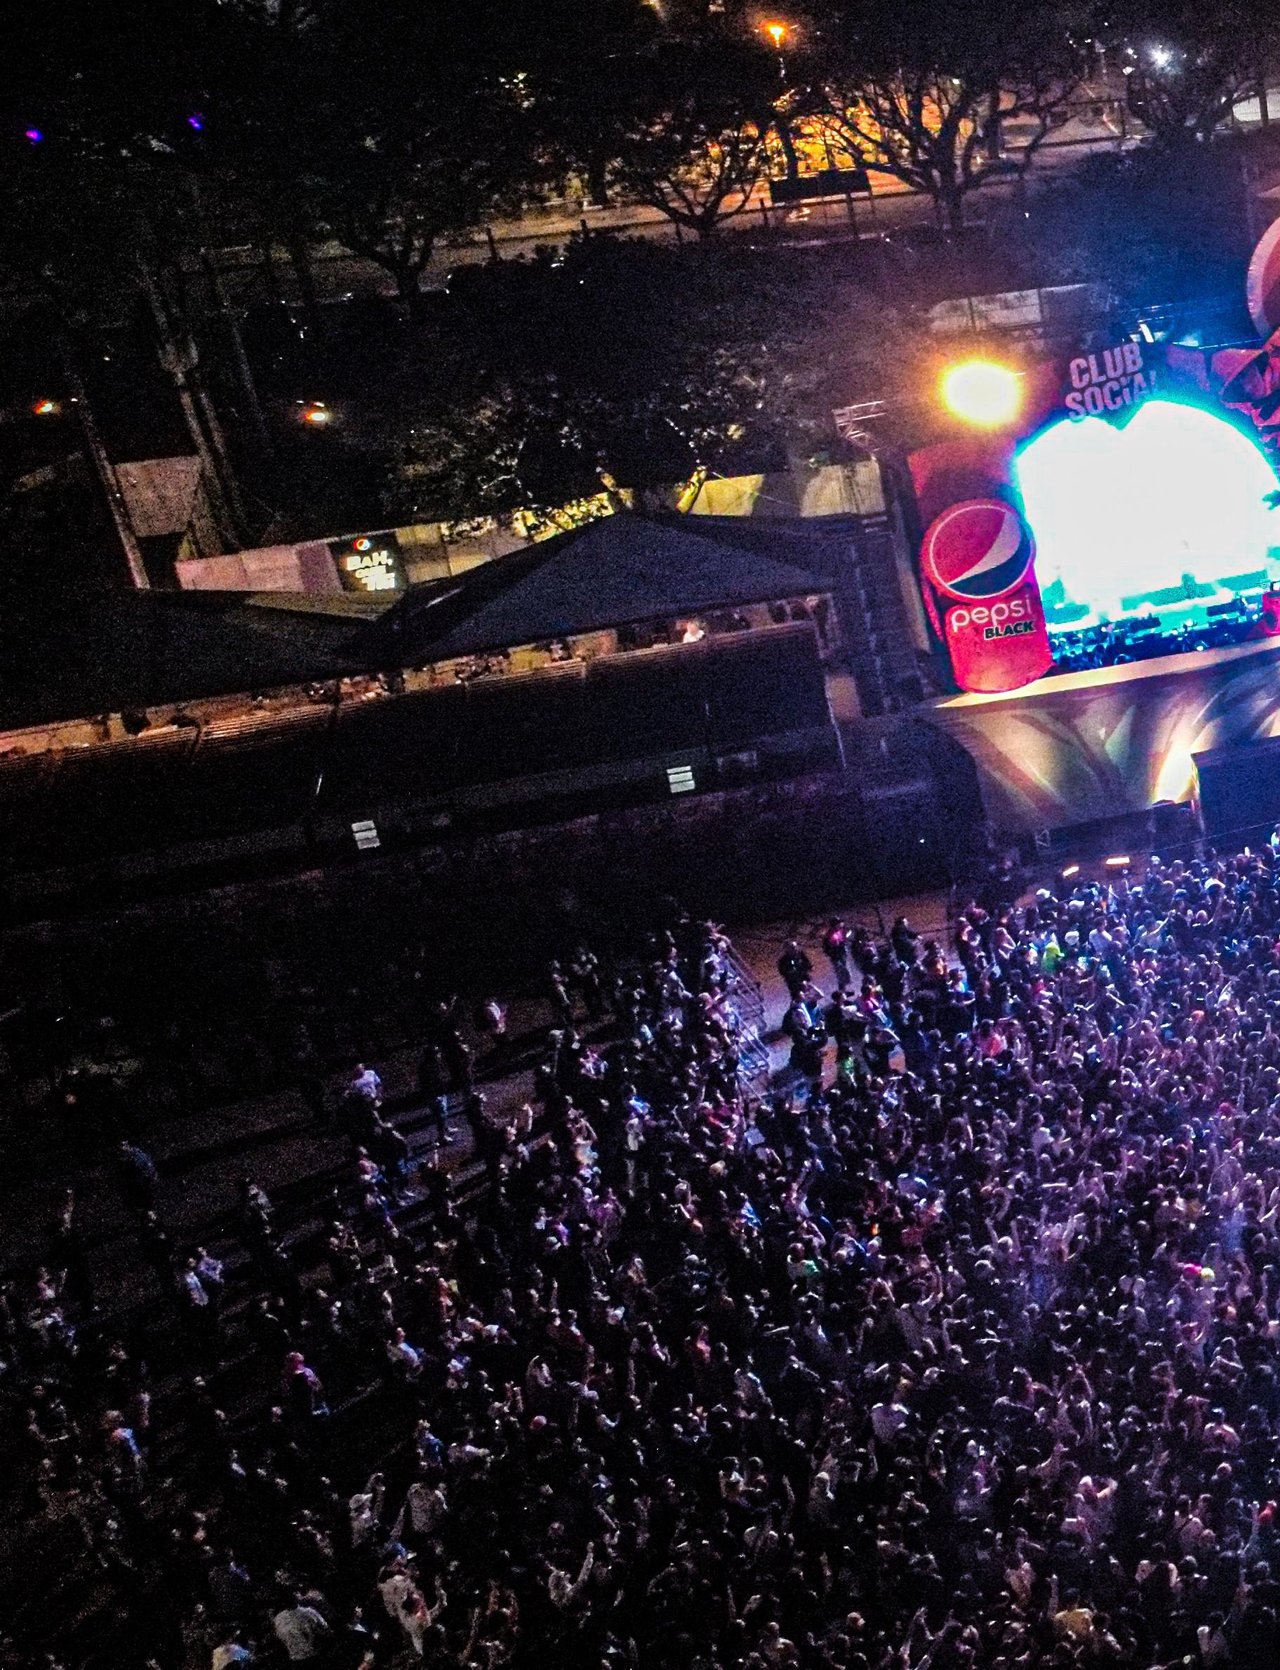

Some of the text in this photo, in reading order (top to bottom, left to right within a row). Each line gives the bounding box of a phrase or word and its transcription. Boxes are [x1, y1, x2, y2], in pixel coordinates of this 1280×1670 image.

[1068, 342, 1144, 389] CLUB
[951, 594, 1032, 633] pepsi
[984, 619, 1037, 640] BLACK
